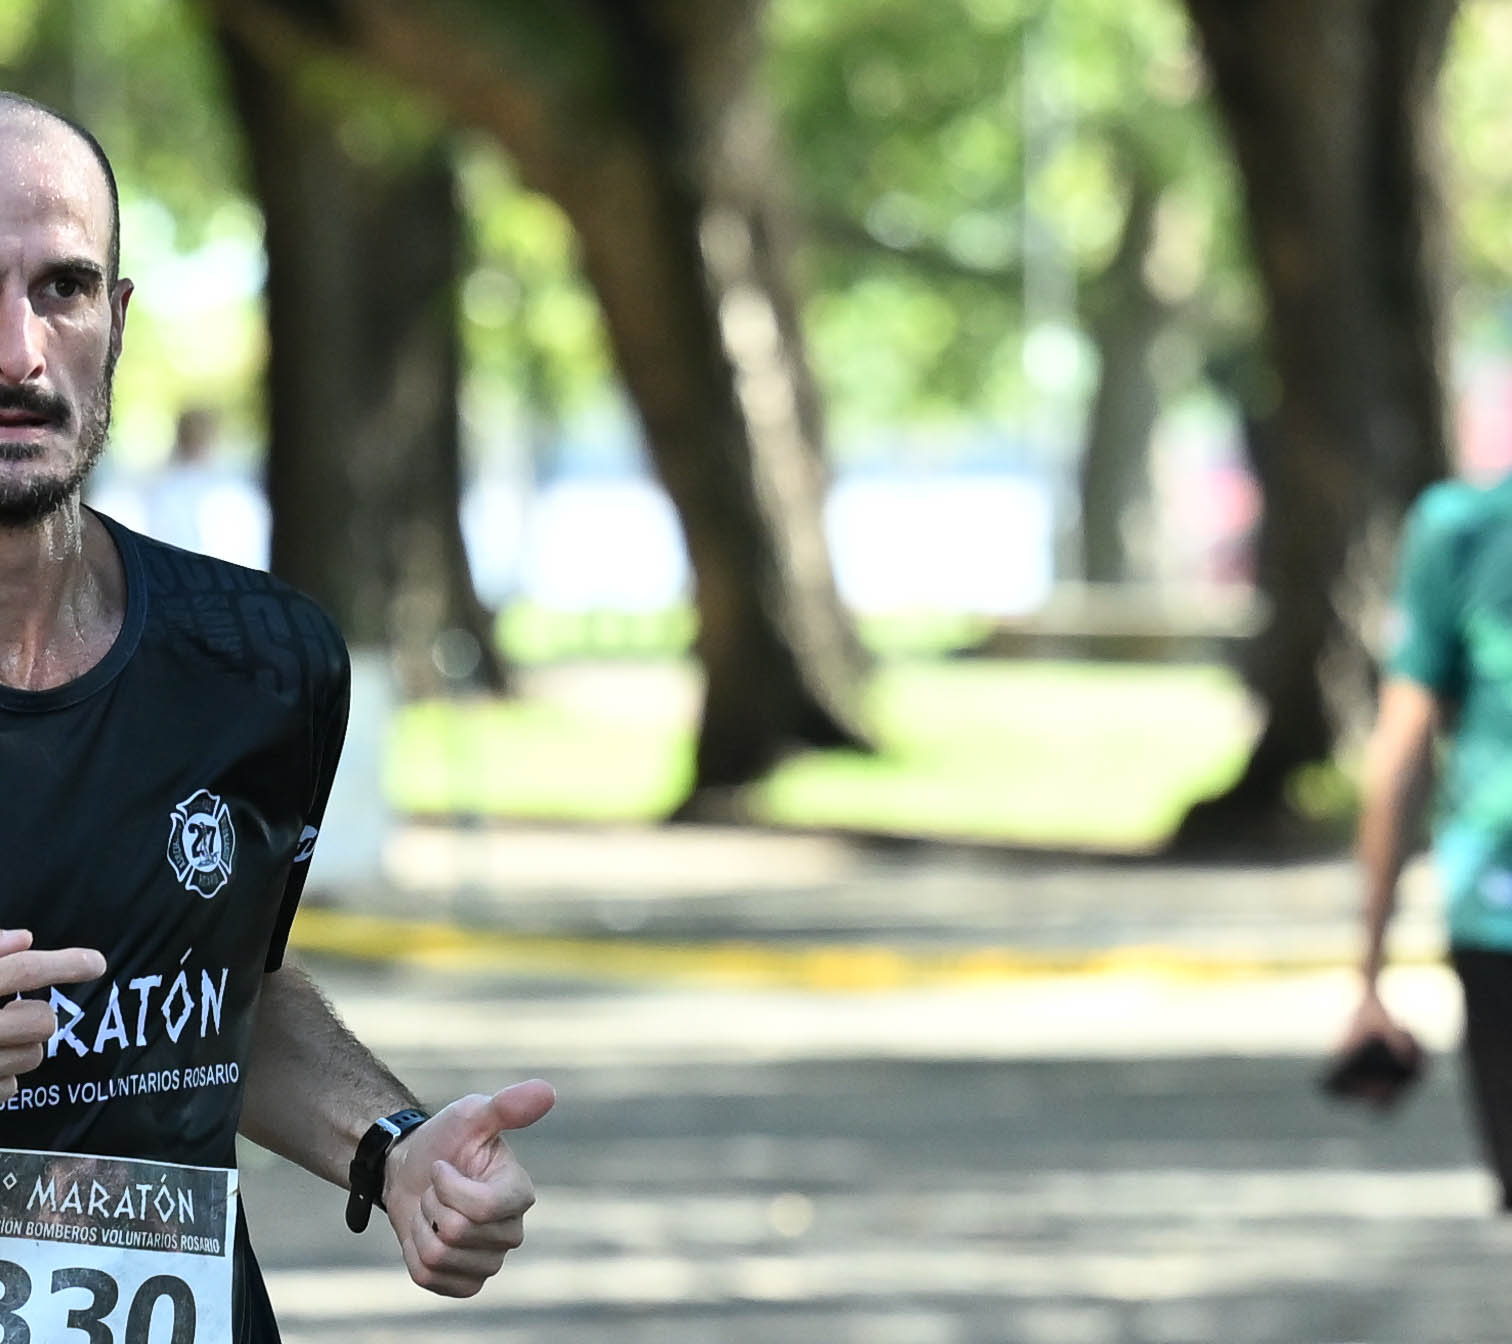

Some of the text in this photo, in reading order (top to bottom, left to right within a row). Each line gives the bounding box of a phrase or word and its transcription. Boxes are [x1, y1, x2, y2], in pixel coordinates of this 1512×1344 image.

[188, 823, 217, 858] 27
[67, 1069, 180, 1104] VOLUNTARIOS
[183, 1061, 240, 1089] ROSARIO
[26, 1173, 195, 1225] MARATÓN
[25, 1220, 97, 1243] BOMBEROS
[100, 1228, 177, 1250] VOLUNTARIOS
[180, 1234, 220, 1254] ROSARIO
